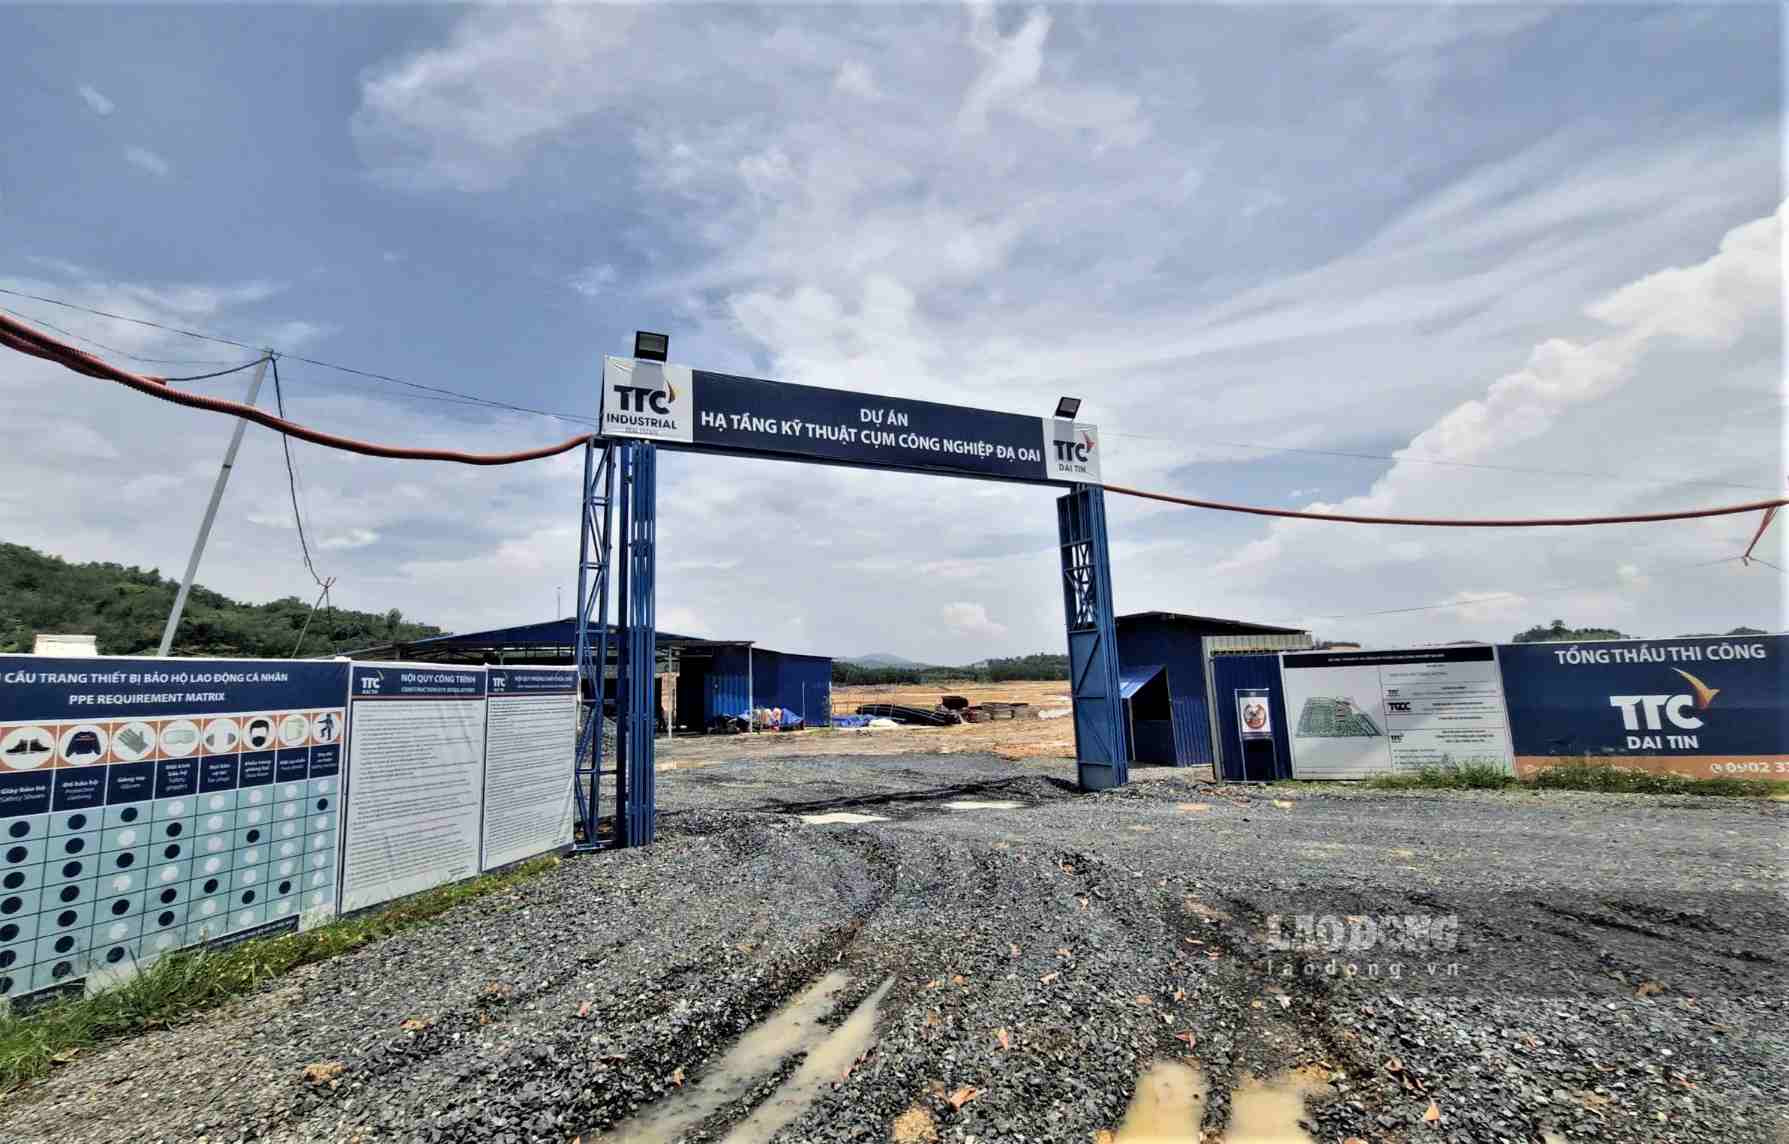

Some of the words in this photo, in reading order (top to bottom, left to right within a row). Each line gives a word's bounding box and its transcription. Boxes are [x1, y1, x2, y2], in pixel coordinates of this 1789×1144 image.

[613, 384, 671, 415] TTC
[606, 413, 678, 430] INDUSTRIAL
[859, 408, 884, 428] DỰ
[886, 409, 909, 427] ÁN
[701, 410, 728, 433] HẠ
[804, 422, 858, 446] THUẬT
[860, 430, 896, 449] CỤM
[898, 432, 941, 452] CÔNG
[943, 439, 994, 460] NGHIỆP
[996, 445, 1017, 463] ĐẠ
[1018, 447, 1041, 463] OAI
[1053, 440, 1088, 462] TTC
[1666, 646, 1702, 662] THI
[1706, 642, 1767, 661] CÔNG
[39, 673, 88, 684] TRANG
[90, 670, 128, 684] THIẾT
[170, 671, 188, 686] HỘ
[190, 673, 212, 683] LAO
[213, 671, 245, 685] ĐỘNG
[246, 671, 259, 683] CÁ
[260, 671, 289, 682] NHÂN
[361, 677, 381, 690] TTC
[416, 674, 434, 684] QUY
[69, 694, 95, 706] PPE
[97, 692, 184, 705] REQUIREMENT
[185, 691, 226, 702] MATRIX
[1610, 694, 1705, 730] TTC
[1626, 735, 1662, 749] DAI
[1666, 735, 1700, 749] TIN
